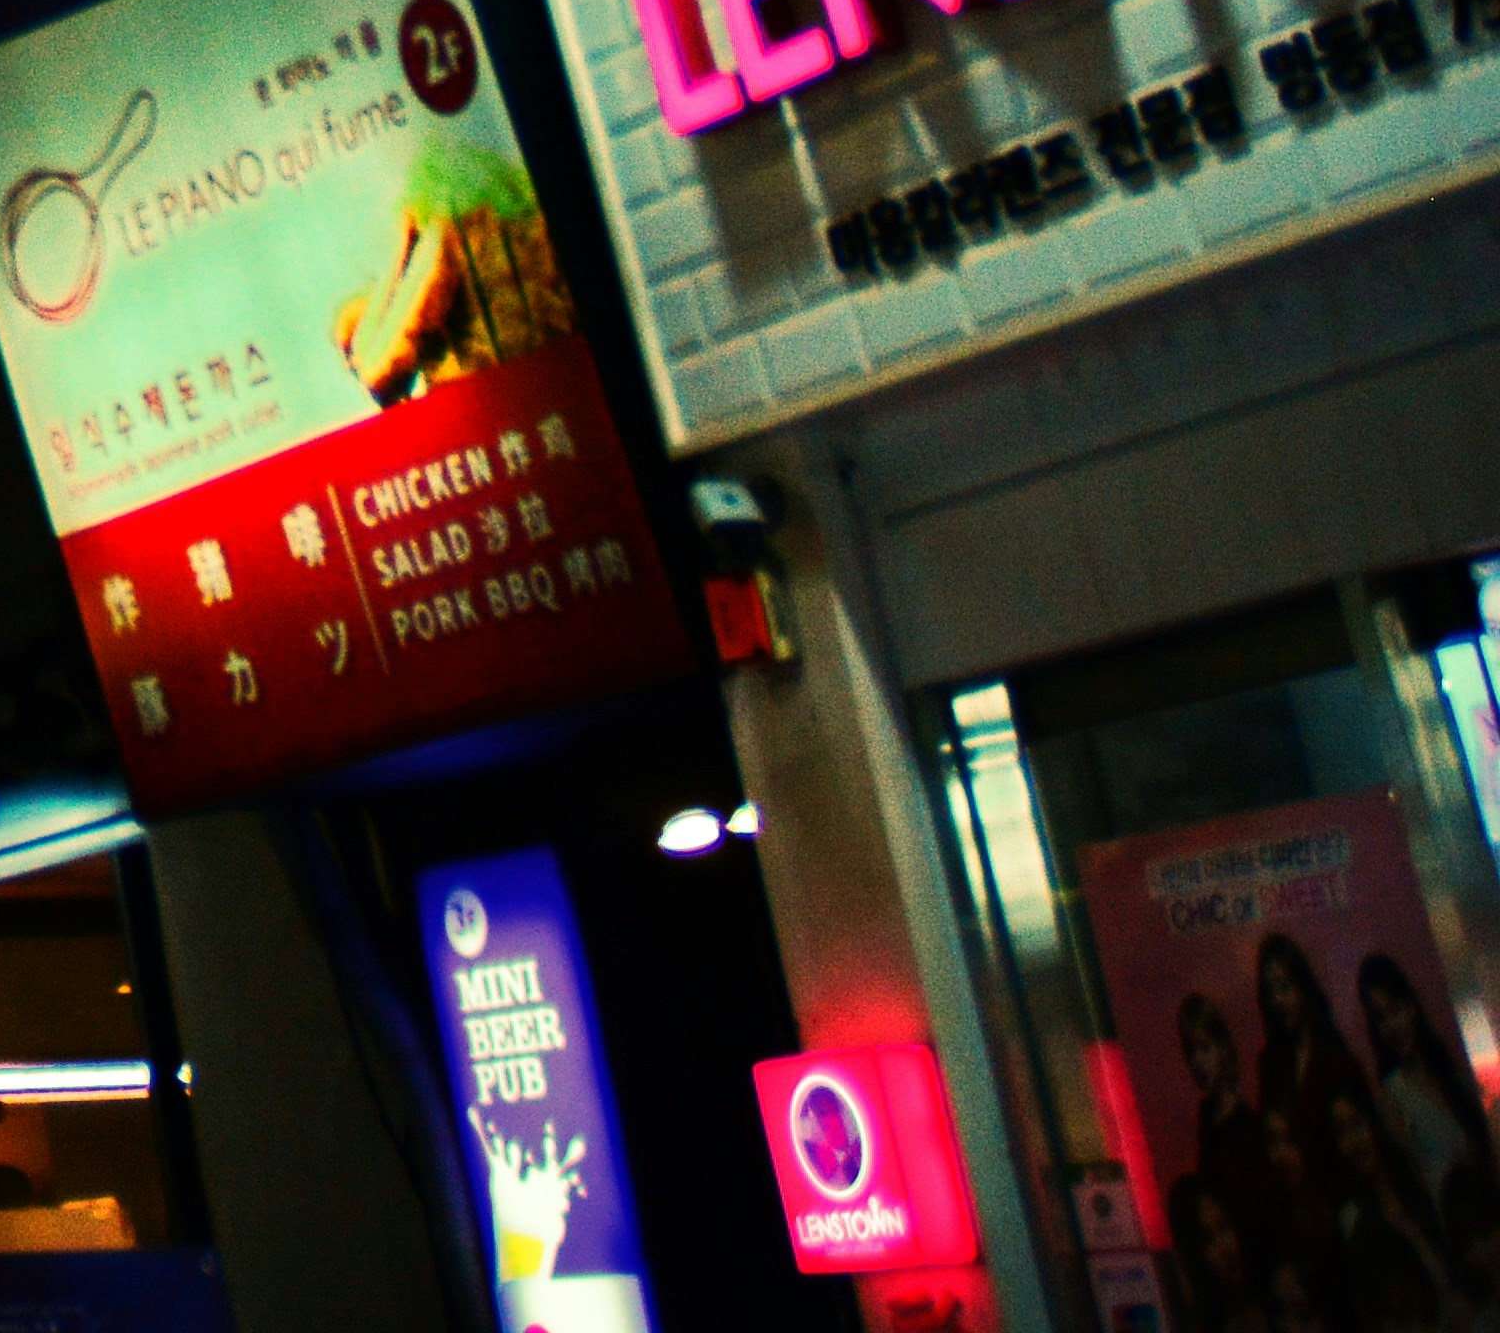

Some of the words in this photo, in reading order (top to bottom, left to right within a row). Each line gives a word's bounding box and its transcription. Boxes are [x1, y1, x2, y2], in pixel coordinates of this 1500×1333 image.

[352, 444, 494, 529] CHICKEN
[370, 521, 473, 589] SALAD
[390, 585, 481, 646] PORK
[486, 562, 562, 619] BBQ
[453, 959, 543, 1012] MINI
[462, 1008, 566, 1060] BEER
[472, 1056, 548, 1106] PUB
[795, 1197, 906, 1244] LENSTOWN
